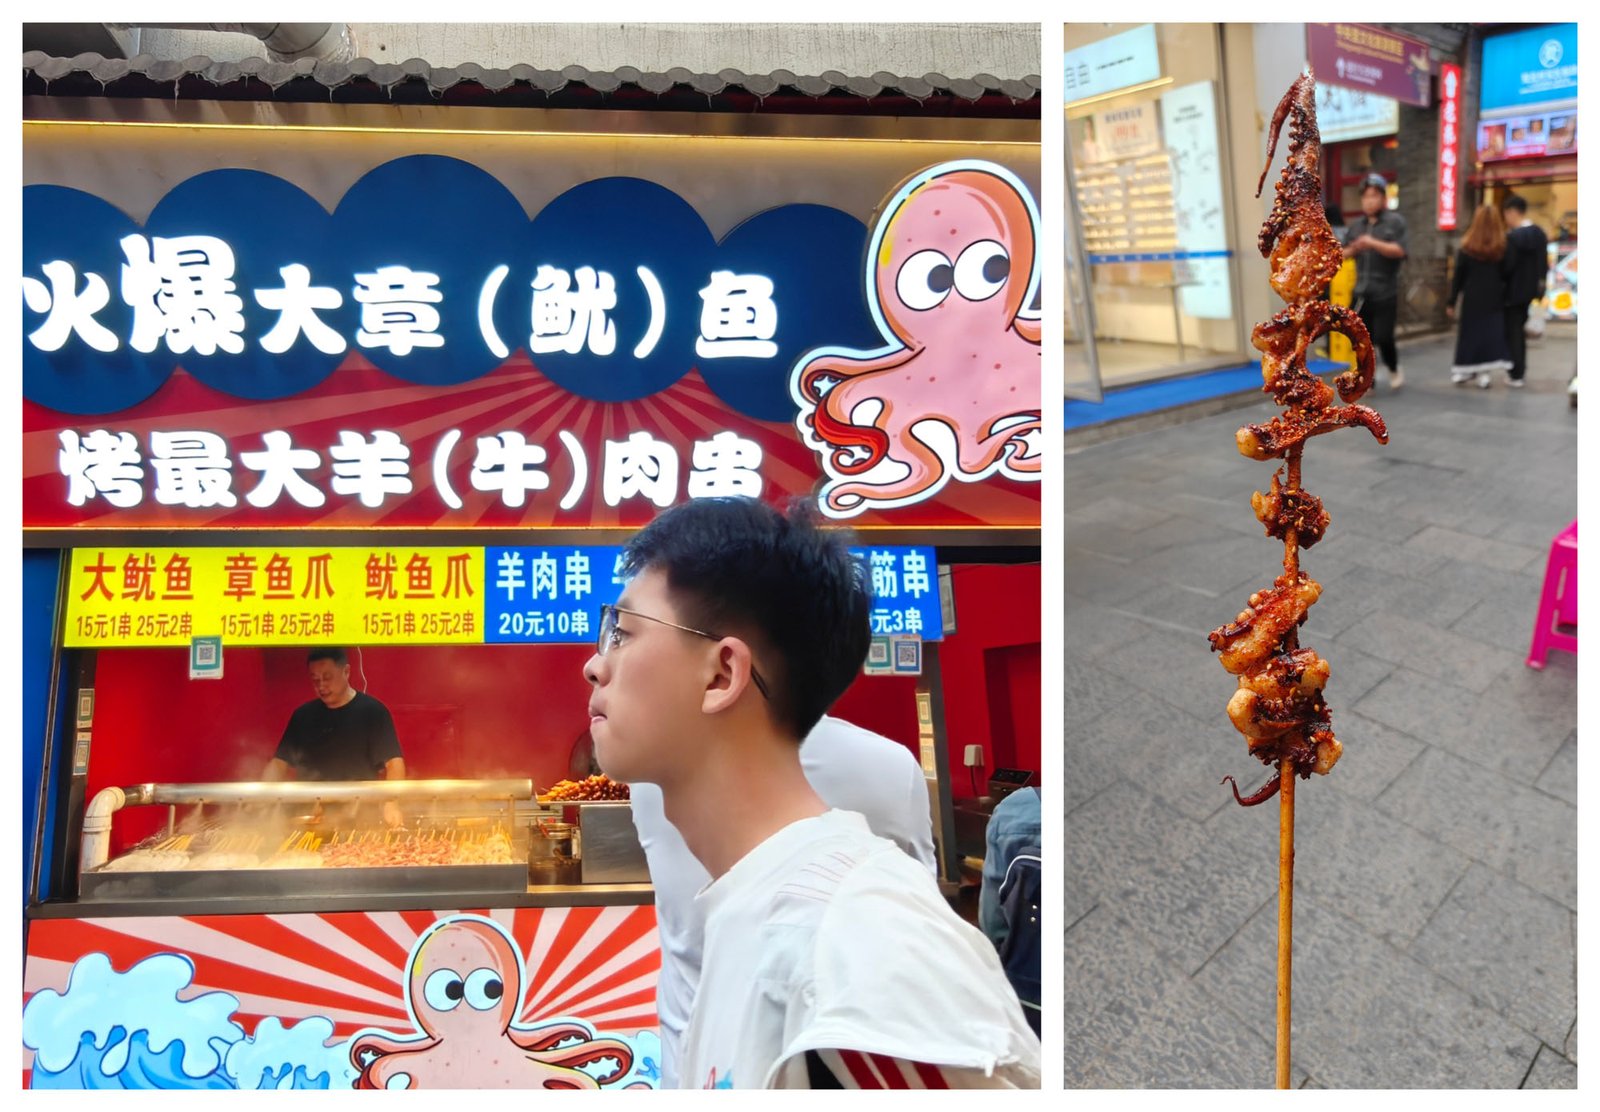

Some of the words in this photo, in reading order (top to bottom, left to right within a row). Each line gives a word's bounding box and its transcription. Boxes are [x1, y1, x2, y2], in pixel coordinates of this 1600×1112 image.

[59, 429, 764, 508] 烤最大羊（牛）肉串
[80, 552, 194, 601] 大鱿鱼
[223, 552, 335, 602] 章鱼爪
[364, 552, 475, 601] 鱿鱼爪
[496, 551, 592, 601] 羊肉串
[848, 550, 929, 599] 筋串
[76, 613, 131, 638] 15元1串
[137, 612, 193, 637] 25元2串
[220, 613, 275, 637] 15元1串
[279, 611, 335, 637] 25元2串
[362, 612, 416, 636] 15元1串
[421, 611, 475, 636] 25元2串
[499, 609, 590, 636] 20元10串
